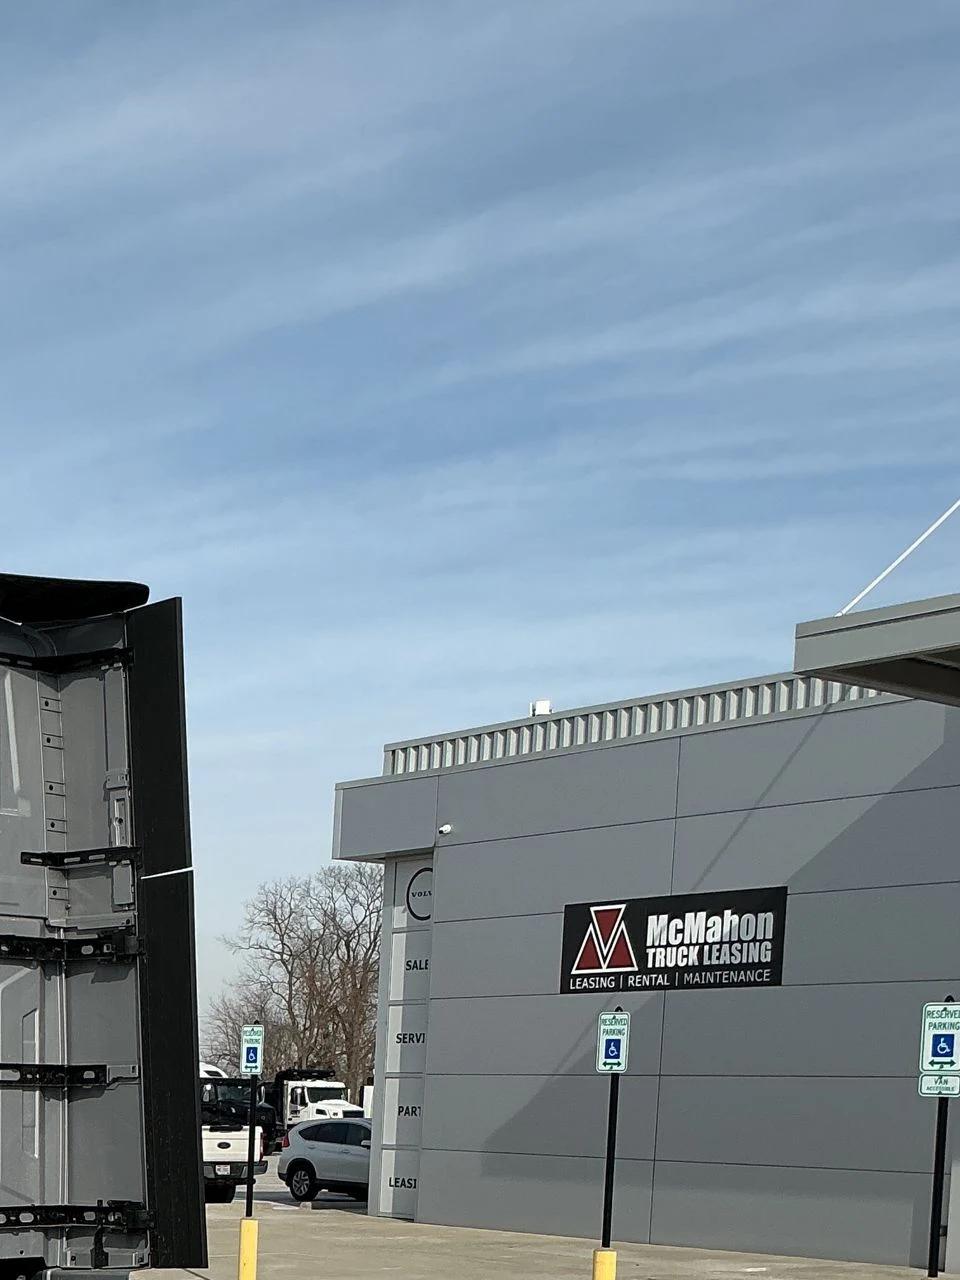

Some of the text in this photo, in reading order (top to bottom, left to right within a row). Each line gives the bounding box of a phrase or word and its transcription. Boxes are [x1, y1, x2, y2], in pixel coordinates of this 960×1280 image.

[645, 909, 774, 947] McMahon
[646, 941, 772, 968] TRUCK LEASING
[570, 969, 771, 990] LEASING RENTAL MAINTENANCE
[602, 1028, 626, 1036] PARKING
[928, 1021, 960, 1031] PARKING
[933, 1078, 949, 1086] VAN
